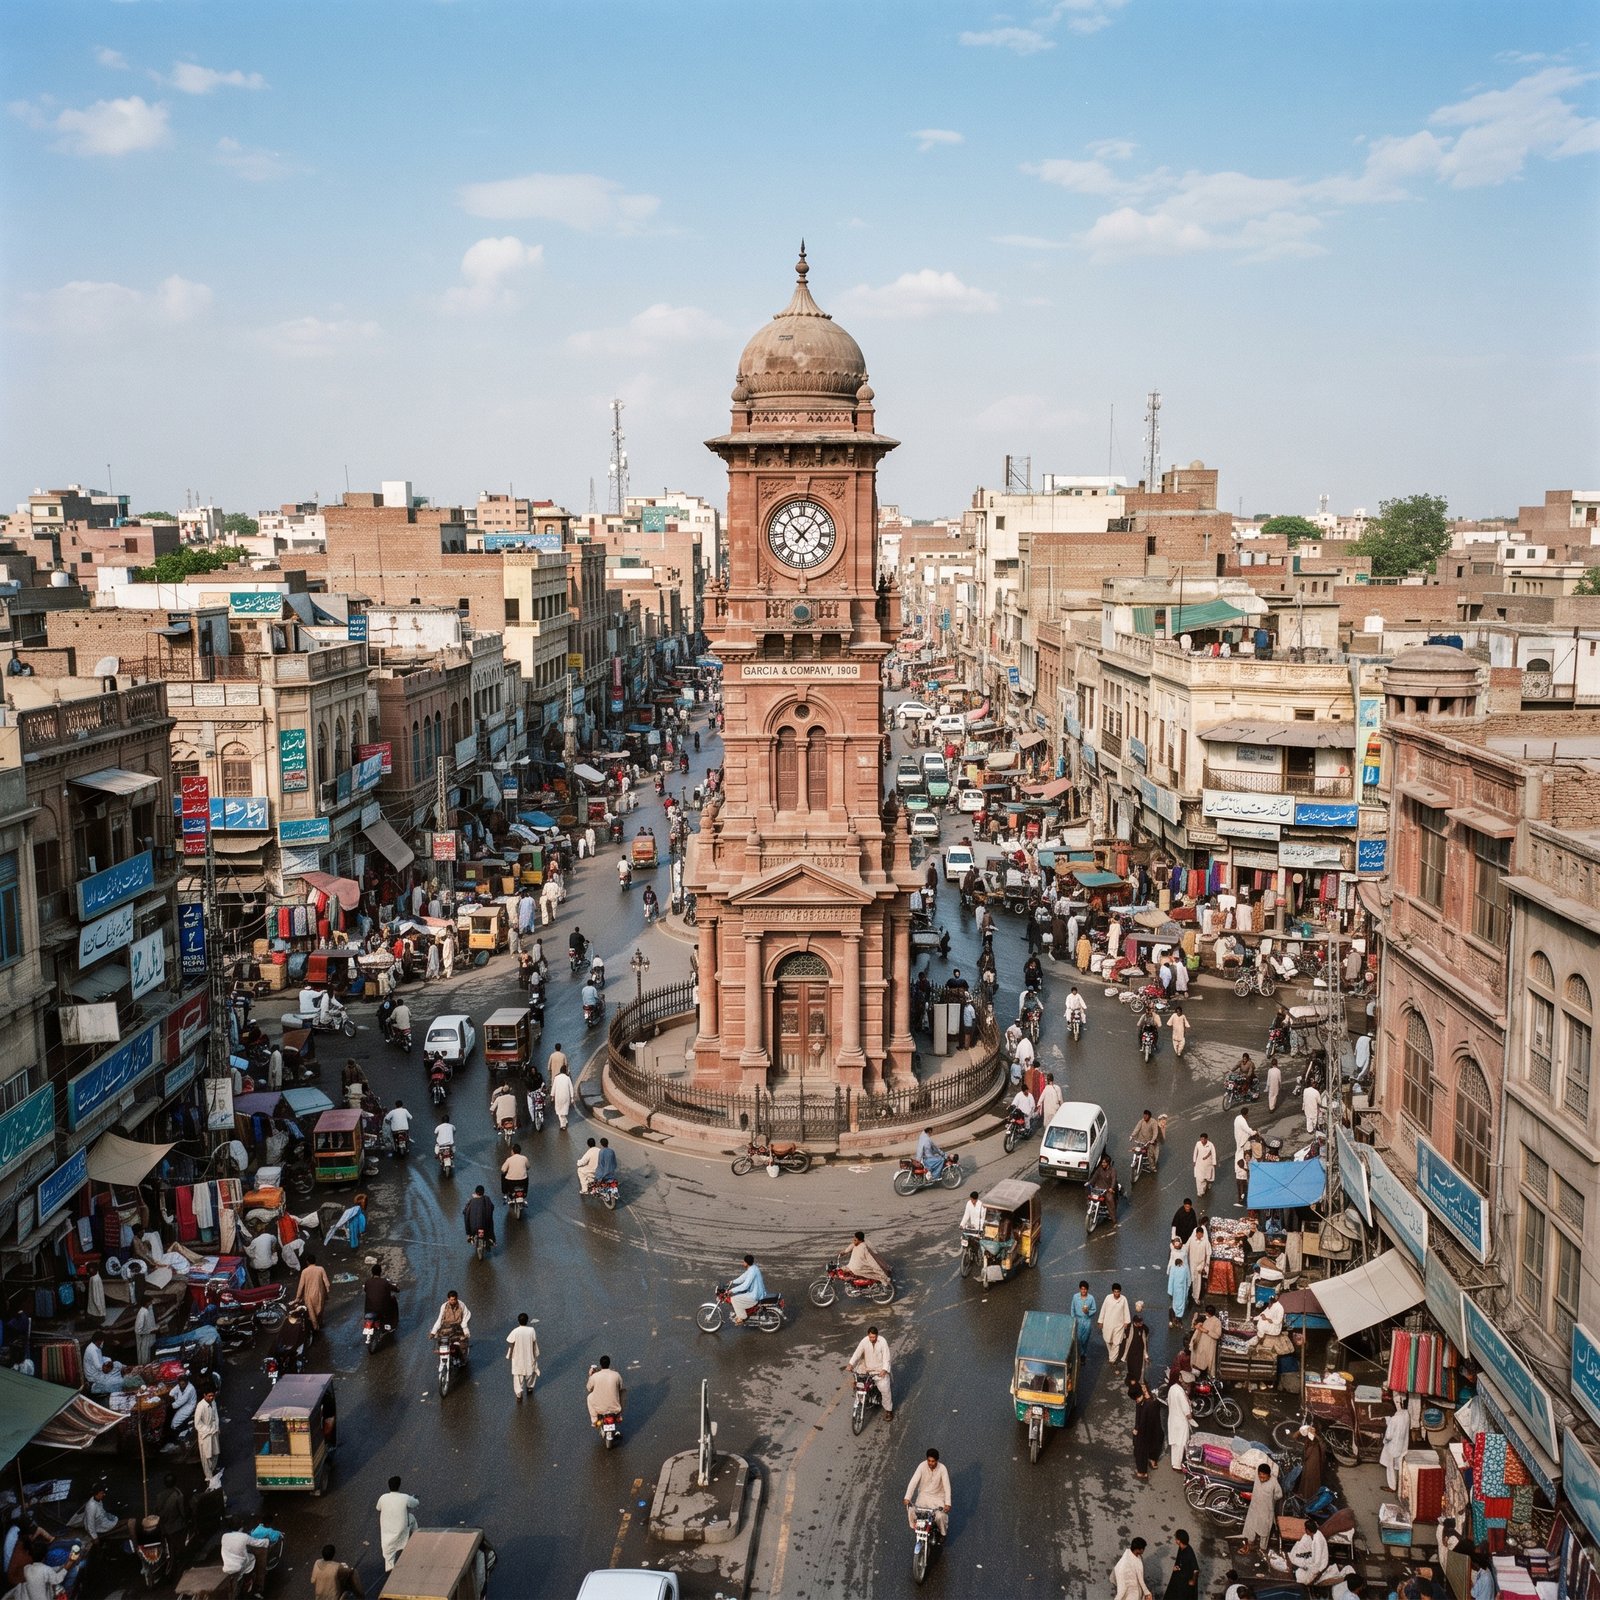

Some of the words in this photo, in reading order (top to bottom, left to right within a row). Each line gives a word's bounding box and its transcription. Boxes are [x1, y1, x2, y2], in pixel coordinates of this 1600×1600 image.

[743, 666, 779, 675] GARCIA
[781, 666, 788, 675] &
[790, 666, 834, 676] COMPANY,
